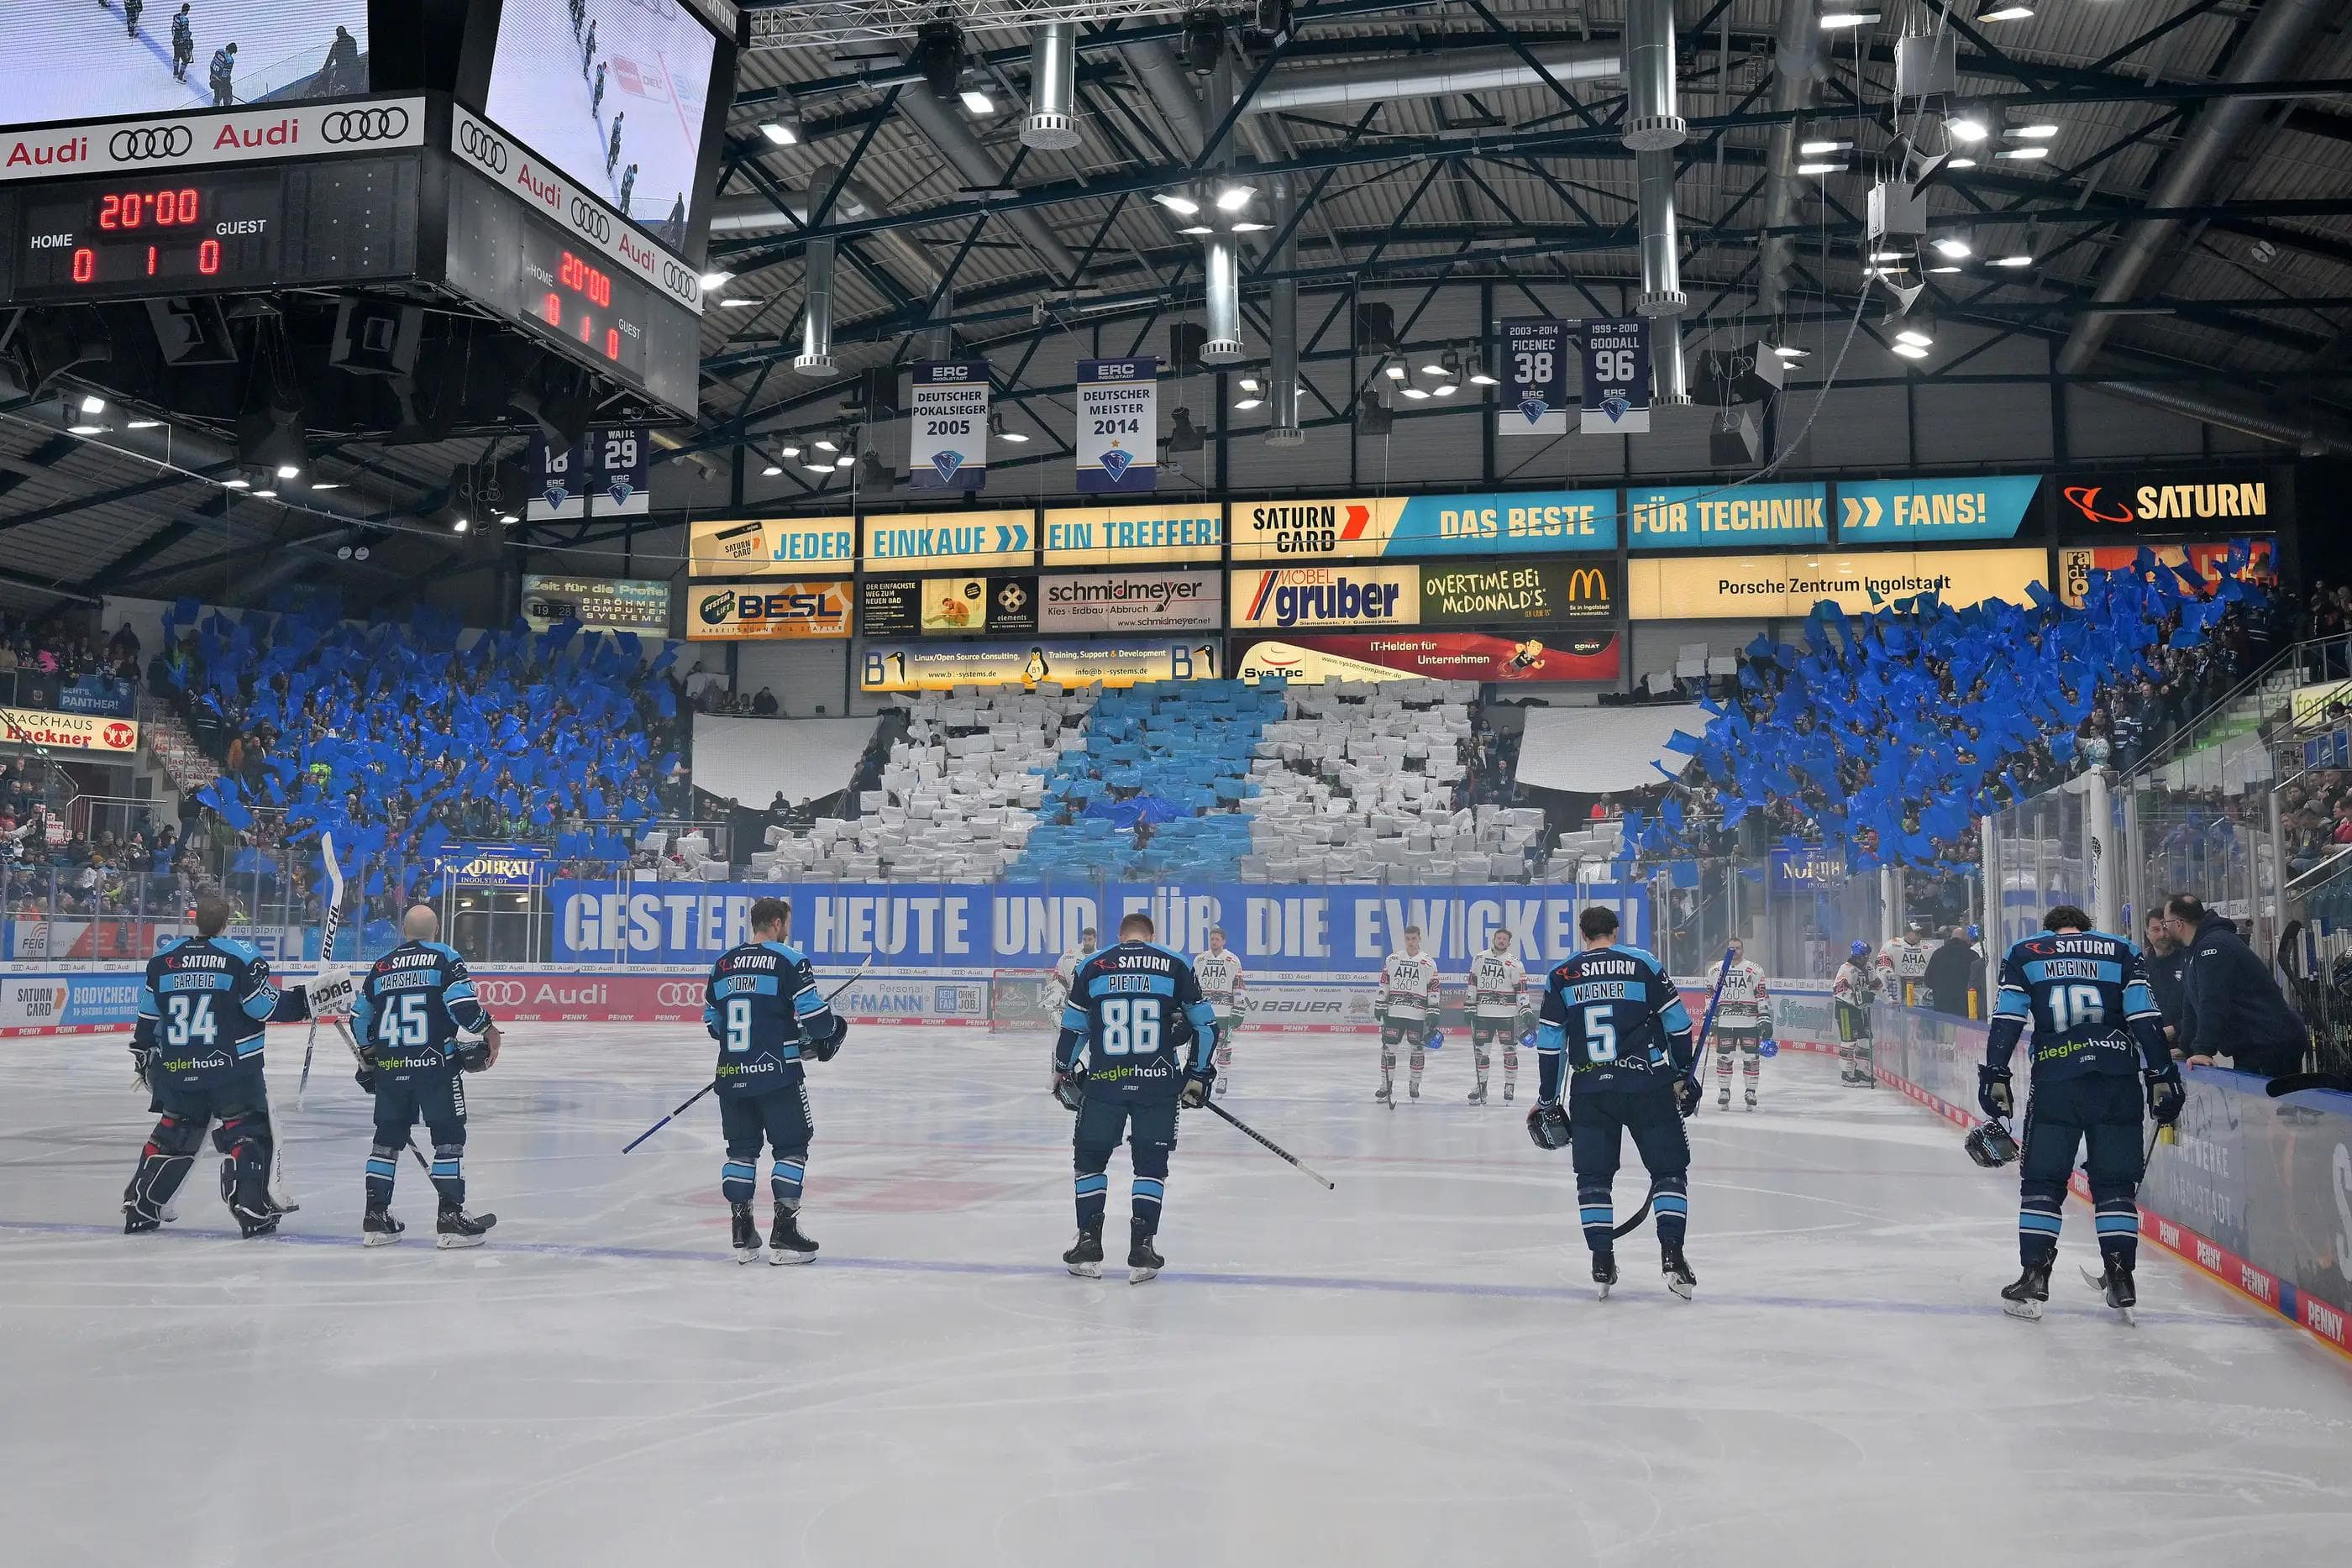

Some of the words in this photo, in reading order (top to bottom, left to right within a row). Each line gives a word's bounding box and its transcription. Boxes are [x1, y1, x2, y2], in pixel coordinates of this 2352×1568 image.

[213, 118, 298, 149] Audi
[6, 137, 87, 167] Audi
[517, 164, 561, 210] Audi
[216, 220, 266, 236] GUEST
[31, 233, 73, 249] HOME
[147, 246, 157, 275] 1
[198, 239, 220, 274] 0
[618, 233, 655, 274] Audi
[73, 248, 95, 283] 0
[531, 265, 554, 287] HOME
[618, 318, 641, 339] GUEST
[1512, 339, 1556, 351] FICENEC
[1591, 337, 1640, 349] GOODALL
[932, 366, 968, 377] ERC
[1098, 364, 1134, 375] ERC
[1515, 353, 1553, 383] 38
[1596, 350, 1634, 381] 96
[918, 391, 982, 402] DEUTSCHER
[1083, 389, 1150, 401] DEUTSCHER
[913, 405, 986, 417] POKALSIEGER
[1089, 403, 1144, 414] MEISTER
[927, 420, 970, 435] 2005
[1094, 418, 1139, 435] 2014
[605, 440, 637, 469] 29
[2136, 483, 2266, 519] SATURN
[1253, 506, 1335, 530] SATURN
[1441, 509, 1498, 539] DAS
[1509, 506, 1594, 537] BESTE
[1633, 496, 1688, 533] FÜR
[1697, 497, 1824, 532] TECHNIK
[1894, 493, 1986, 526] FANS!
[725, 538, 750, 553] SATURN
[774, 532, 851, 560] JEDER
[874, 527, 986, 557] EINKAUF
[1049, 523, 1092, 550] EIN
[1102, 518, 1221, 548] TREFFER!
[1277, 530, 1335, 553] CARD
[733, 548, 751, 559] CARD
[1278, 569, 1334, 585] MÖBEL
[1719, 579, 1785, 594] Porsche
[1790, 578, 1859, 593] Zentrum
[1865, 574, 1950, 594] Ingolstadt
[564, 583, 587, 591] für
[1048, 579, 1202, 607] schmidmeyer
[582, 597, 666, 607] STRÖHMER
[705, 591, 732, 612] SYSTEM
[738, 594, 843, 619] BESL
[1276, 578, 1399, 627] gruber
[537, 606, 549, 615] 19
[582, 606, 666, 615] COMPUTER
[586, 612, 662, 622] SYSTEME
[717, 604, 731, 616] LIFT
[1072, 606, 1103, 615] Erdbau
[1110, 605, 1148, 614] Abbruch
[1117, 616, 1210, 627] www.schmidmeyer.net
[1048, 651, 1079, 659] Training,
[1080, 650, 1108, 659] Support
[1119, 649, 1166, 658] Development
[1370, 641, 1418, 652] IT-Helden
[1421, 641, 1437, 650] für
[914, 653, 955, 662] Linux/Open
[1418, 655, 1490, 664] Unternehmen
[8, 713, 92, 731] BACKHAUS
[6, 725, 92, 745] Hackner
[814, 897, 969, 954] HEUTE
[995, 897, 1098, 955] UND
[1247, 898, 1330, 957] DIE
[22, 938, 45, 950] FEIG
[2055, 941, 2115, 956] SATURN
[181, 955, 226, 969] SATURN
[392, 954, 437, 969] SATURN
[732, 956, 777, 970] SATURN
[1118, 956, 1170, 972] SATURN
[1902, 954, 1926, 964] AHA
[1202, 966, 1226, 978] AHA
[1394, 966, 1419, 981] AHA
[1481, 965, 1505, 978] AHA
[1581, 960, 1635, 977] SATURN
[2044, 961, 2098, 980] MCGINN
[174, 973, 215, 989] GARTEIG
[381, 970, 430, 991] MARSHALL
[727, 976, 756, 993] STORM
[879, 983, 924, 994] Personal
[1109, 975, 1151, 993] PIETTA
[1722, 977, 1746, 989] AHA
[18, 989, 53, 1002] SATURN
[74, 986, 139, 1004] BODYCHECK
[533, 984, 607, 1004] Audi
[939, 989, 954, 999] KEIN
[958, 989, 977, 999] OHNE
[1573, 983, 1626, 1002] WAGNER
[26, 1003, 51, 1017] CARD
[939, 999, 954, 1009] FAN
[2049, 984, 2104, 1034] 16
[167, 994, 218, 1046] 34
[379, 994, 428, 1047] 45
[727, 999, 752, 1052] 9
[1100, 998, 1161, 1056] 86
[1584, 1005, 1618, 1062] 5
[2038, 1038, 2127, 1061] zieglerhaus
[1091, 1064, 1167, 1081] zieglerhaus
